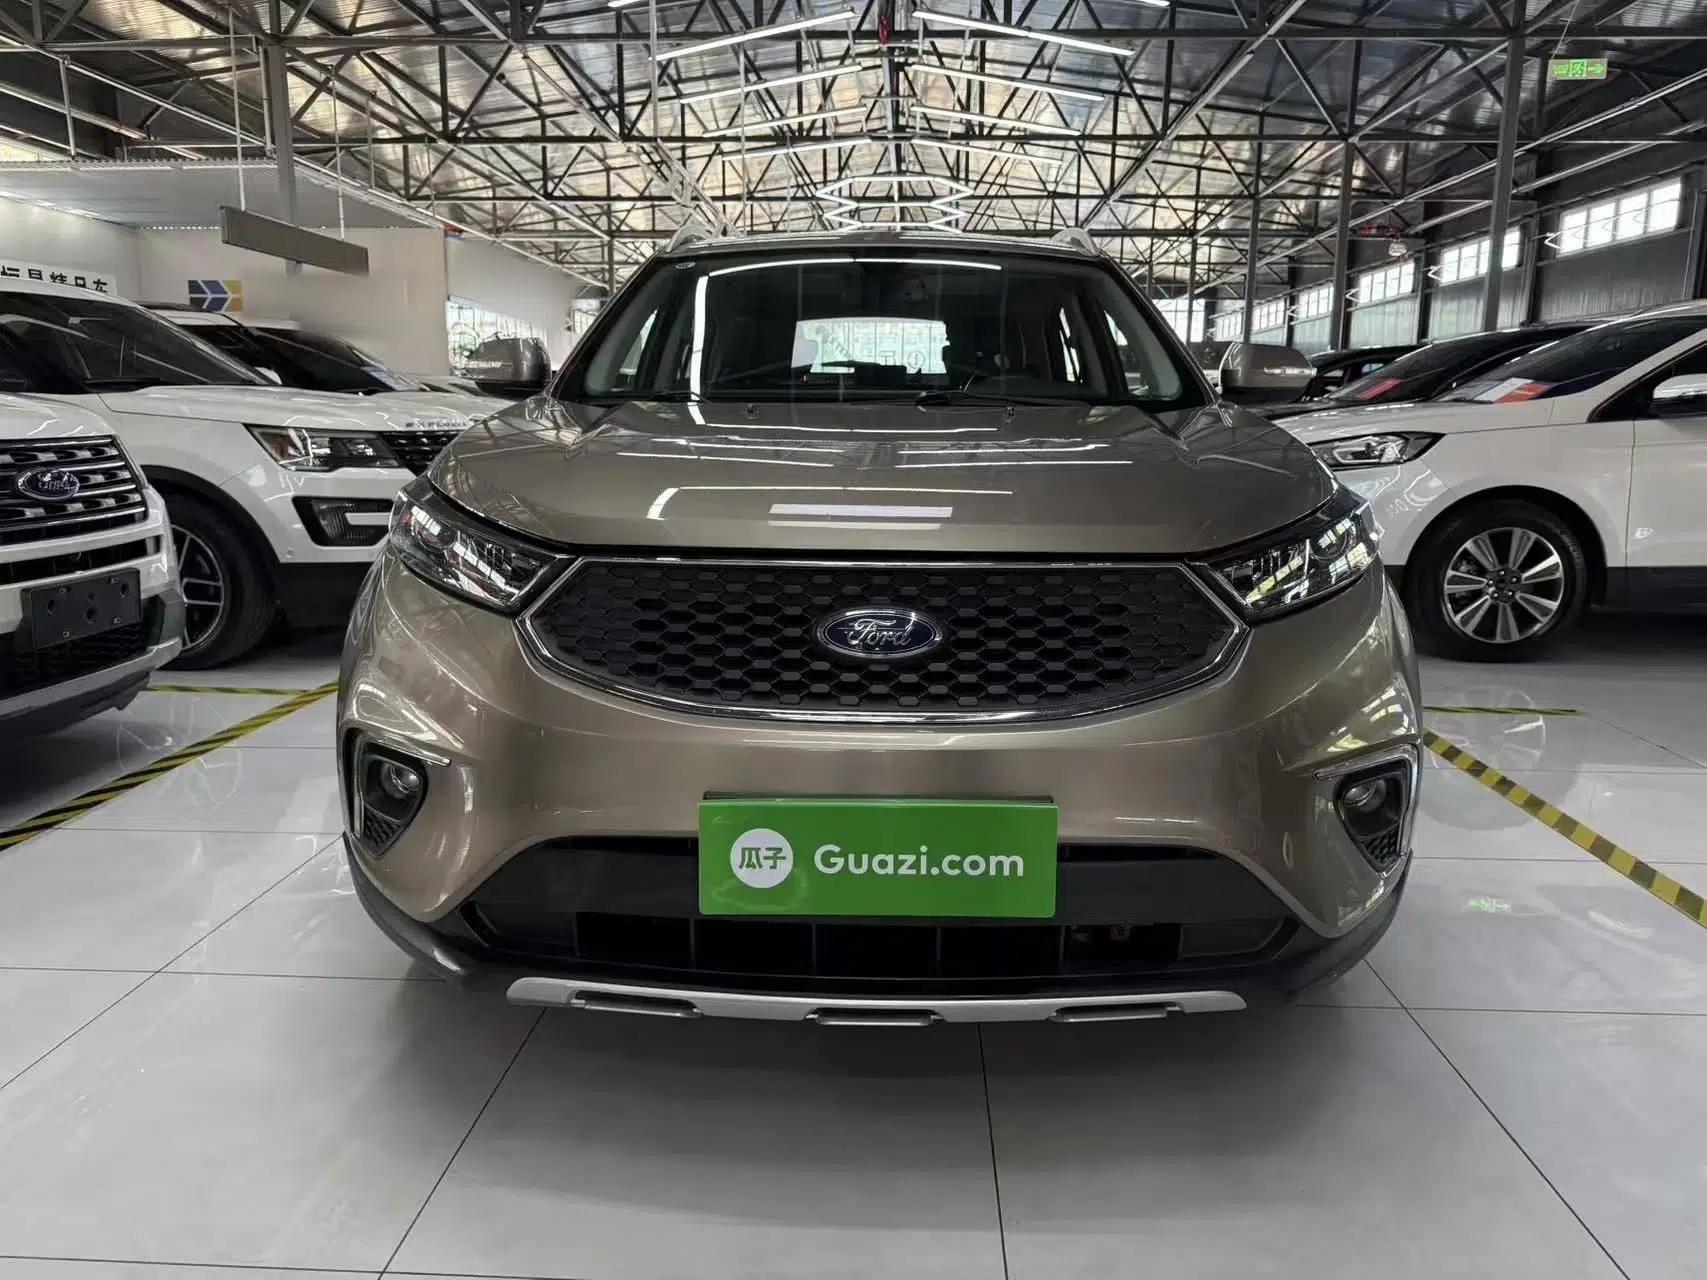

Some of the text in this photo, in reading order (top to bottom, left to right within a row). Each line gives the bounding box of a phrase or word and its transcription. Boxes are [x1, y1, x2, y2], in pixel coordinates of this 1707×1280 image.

[847, 617, 914, 646] Ford
[738, 846, 786, 870] 瓜子
[813, 844, 1024, 877] Guazi.com
